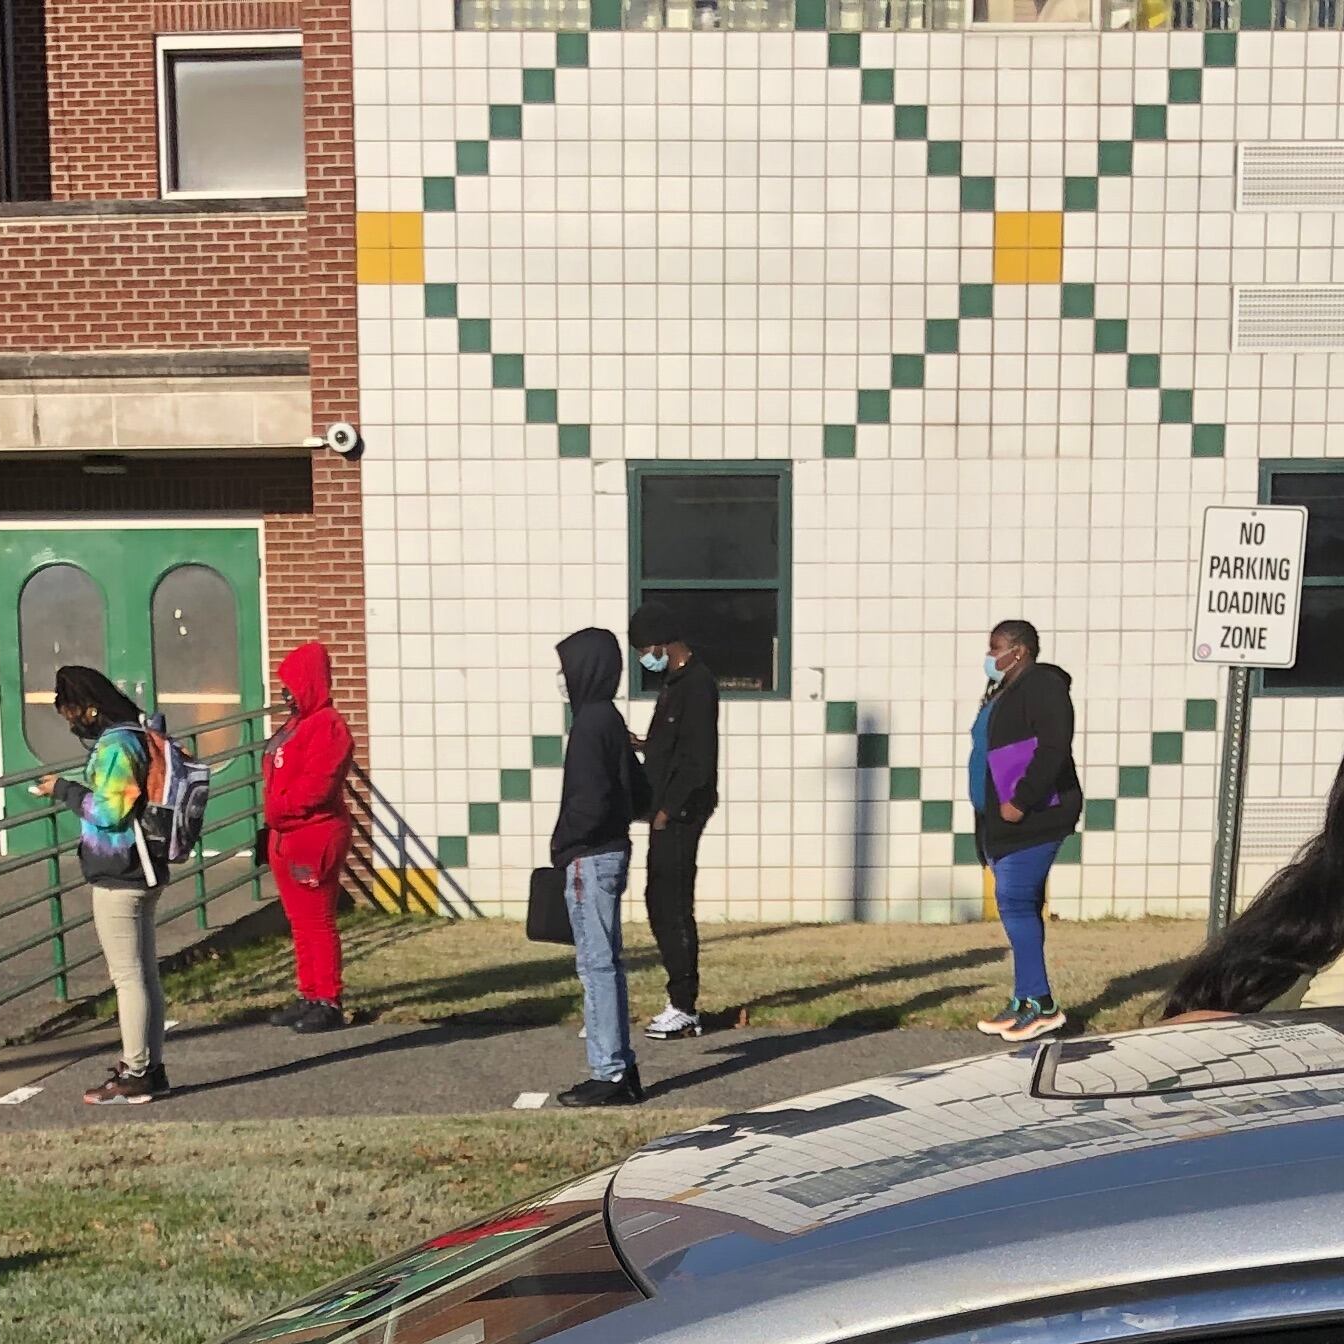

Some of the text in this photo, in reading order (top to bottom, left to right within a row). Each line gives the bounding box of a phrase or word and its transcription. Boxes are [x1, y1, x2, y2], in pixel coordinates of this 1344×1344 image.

[1239, 522, 1265, 545] NO
[1209, 555, 1290, 581] PARKING
[1208, 590, 1286, 615] LOADING
[1220, 626, 1268, 649] ZONE
